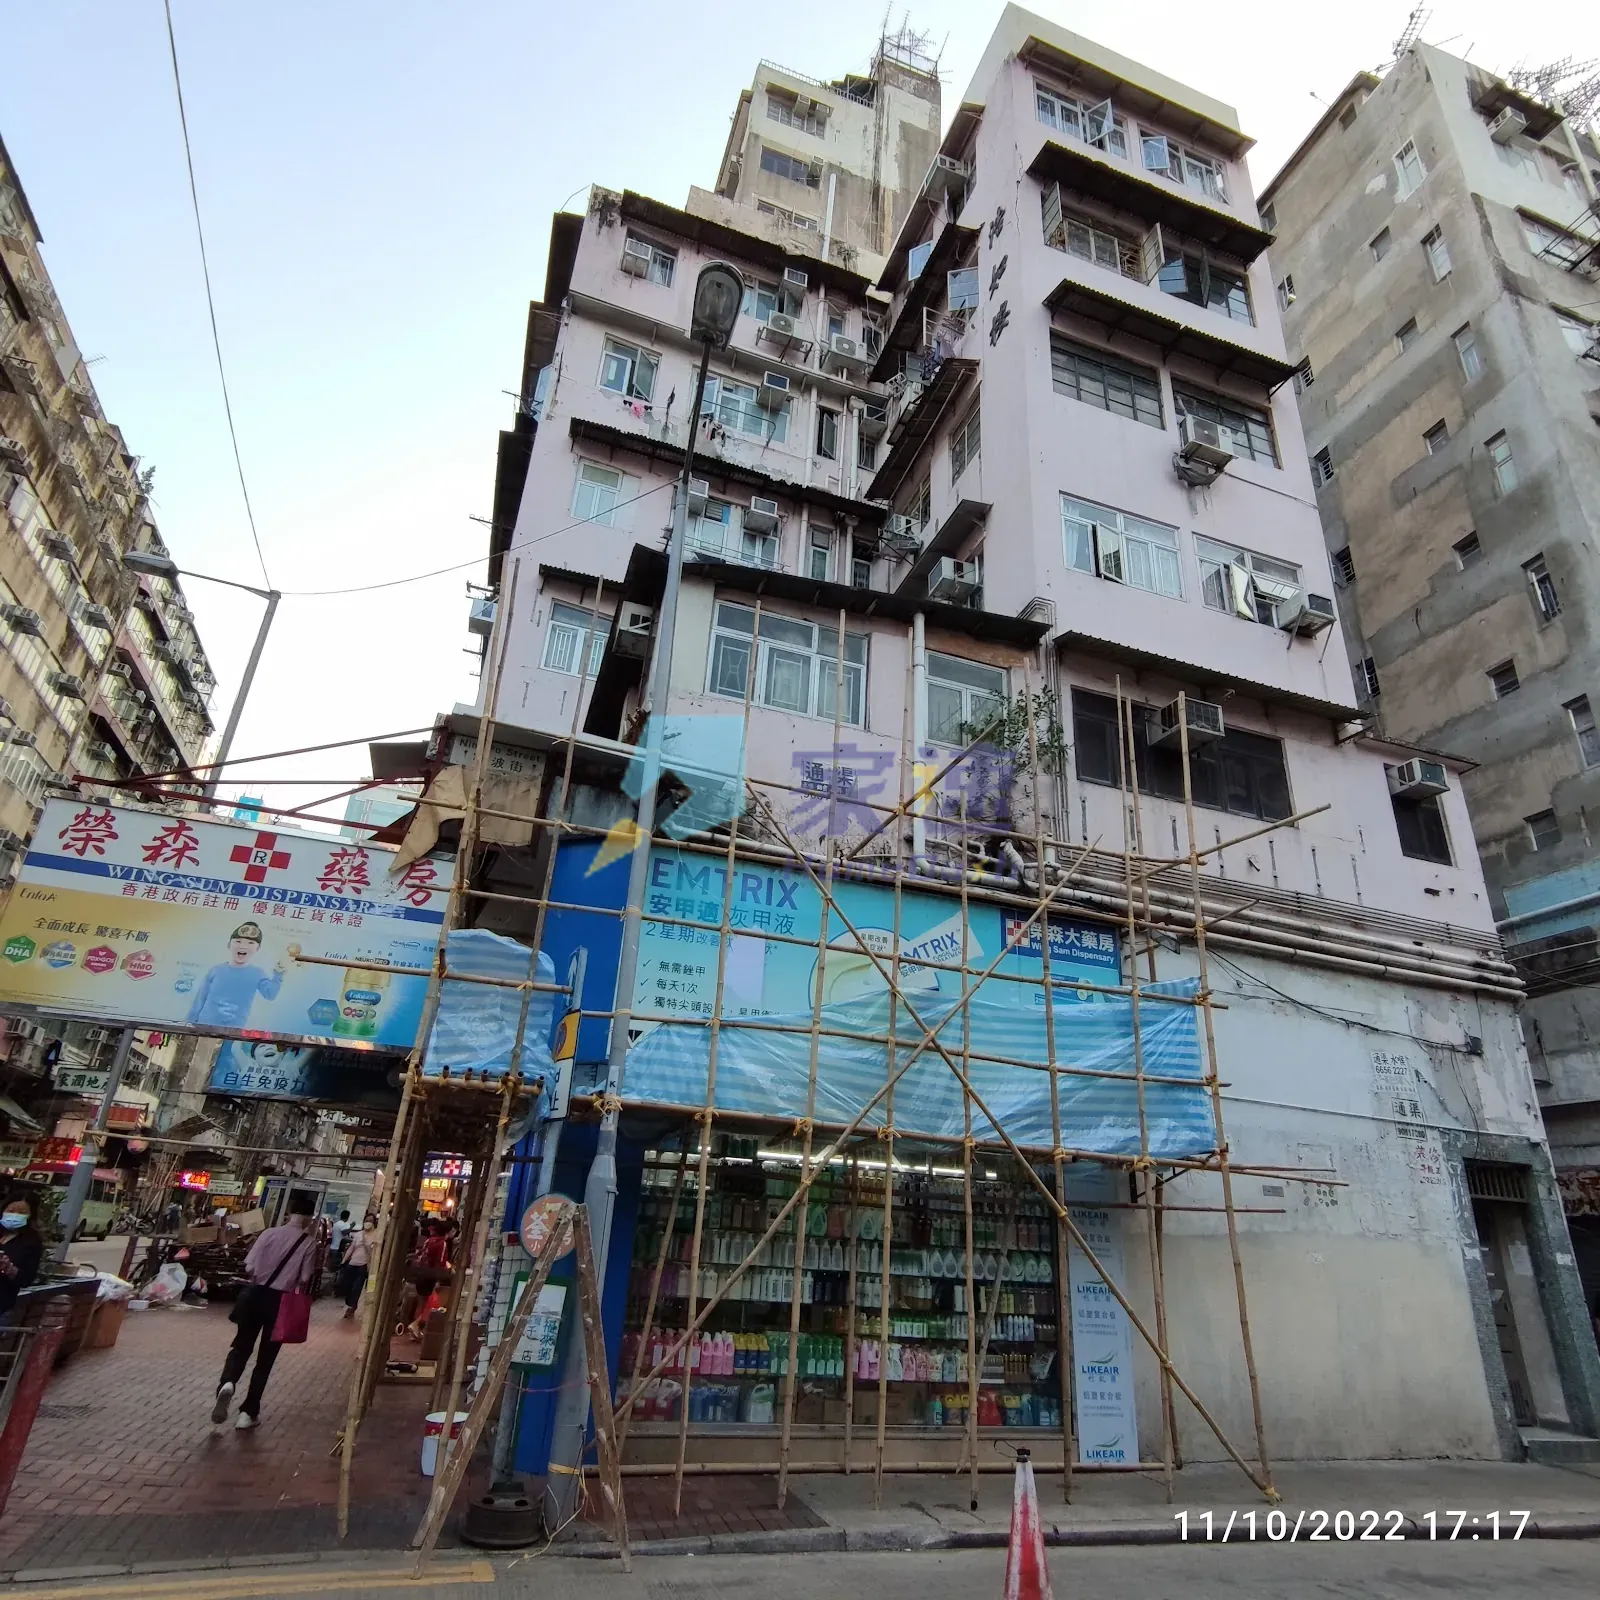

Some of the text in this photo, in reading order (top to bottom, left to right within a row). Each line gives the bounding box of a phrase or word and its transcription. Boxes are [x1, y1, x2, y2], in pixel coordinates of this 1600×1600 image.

[483, 755, 523, 773] 波街
[507, 747, 541, 763] Street
[59, 806, 200, 871] 榮森
[107, 864, 175, 886] WING
[185, 875, 235, 894] SUM
[651, 857, 799, 911] EMTRIX
[122, 882, 363, 928] 香港政府註冊 優質正貨保證
[649, 893, 796, 936] 安甲適 灰甲液
[33, 917, 151, 943] 全面成長 驚喜不斷
[1030, 922, 1114, 952] 榮森大藥房
[5, 946, 31, 958] DHA
[1053, 945, 1071, 955] Sam
[1072, 948, 1114, 964] Dispensary
[130, 962, 153, 971] HMO
[656, 978, 699, 995] 每天1次
[223, 1072, 305, 1092] 自生免疫力
[1394, 1102, 1422, 1119] 通渠
[1072, 1210, 1109, 1220] LIKEAIR
[1081, 1365, 1119, 1374] LIKEAIR
[1086, 1449, 1125, 1459] LIKEAIR
